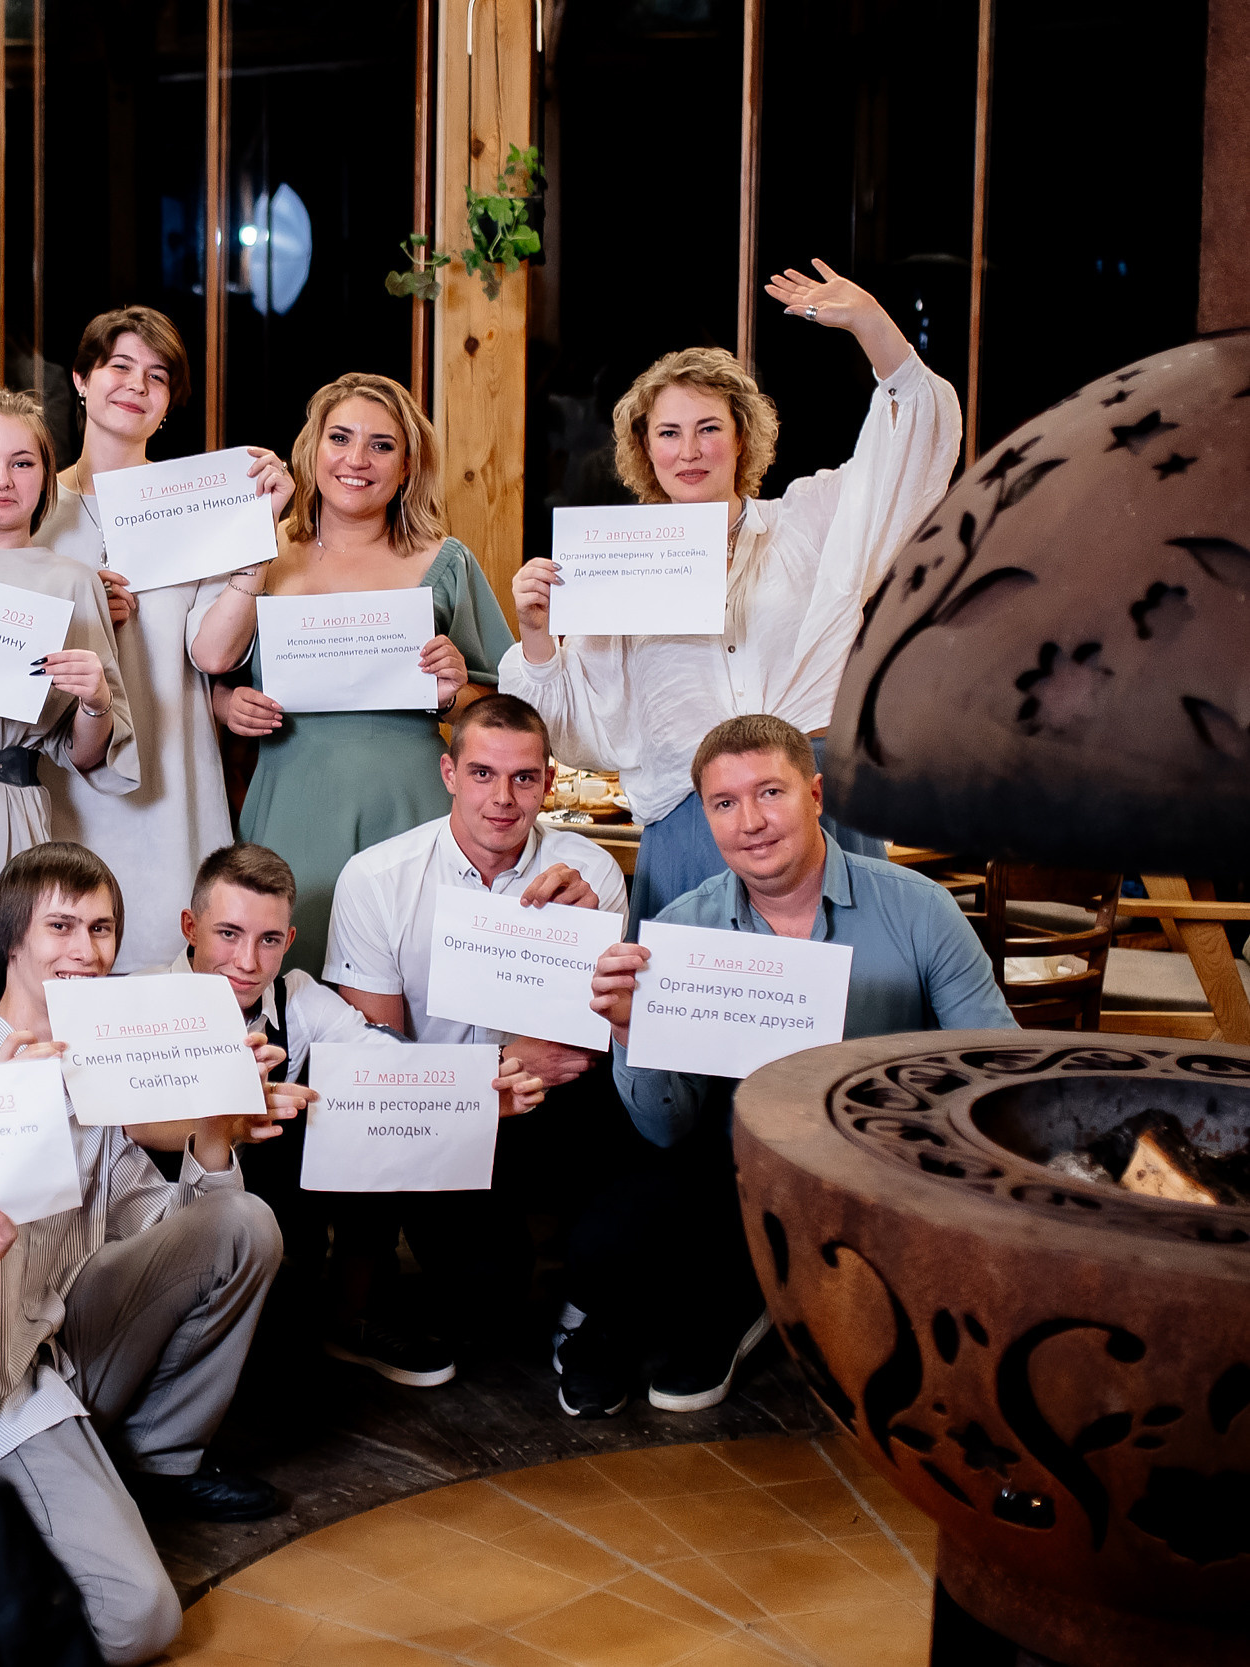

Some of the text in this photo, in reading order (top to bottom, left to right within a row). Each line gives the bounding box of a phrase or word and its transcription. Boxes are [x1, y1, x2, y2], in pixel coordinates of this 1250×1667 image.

[140, 473, 227, 499] 17 июня 2023
[114, 506, 183, 527] Отработаю
[187, 502, 199, 512] за
[585, 526, 685, 542] 17 августа 2023
[560, 552, 606, 561] Организую
[608, 551, 654, 560] вечеринку
[574, 566, 692, 577] Ди джеем выступлю сам(А)
[2, 608, 34, 627] 2023
[301, 612, 390, 628] 17 июля 2023
[287, 637, 326, 647] Исполню
[328, 636, 353, 645] песни
[376, 632, 407, 642] окном,
[275, 645, 420, 661] любимых исполнителей молодых
[472, 915, 579, 944] 17 апреля 2023
[444, 935, 517, 959] Организую
[687, 953, 784, 974] 17 мая 2023
[497, 970, 545, 987] на яхте
[660, 977, 807, 1005] Организую поход в
[647, 1001, 814, 1030] баню для всех друзей
[95, 1016, 207, 1037] 17 января 2023
[72, 1043, 241, 1067] С меня парный прыжок
[129, 1073, 200, 1090] СкайПарк
[354, 1071, 456, 1085] 17 марта 2023
[327, 1098, 480, 1113] Ужин в ресторане для
[20, 1124, 38, 1134] кто
[368, 1126, 431, 1138] молодых
